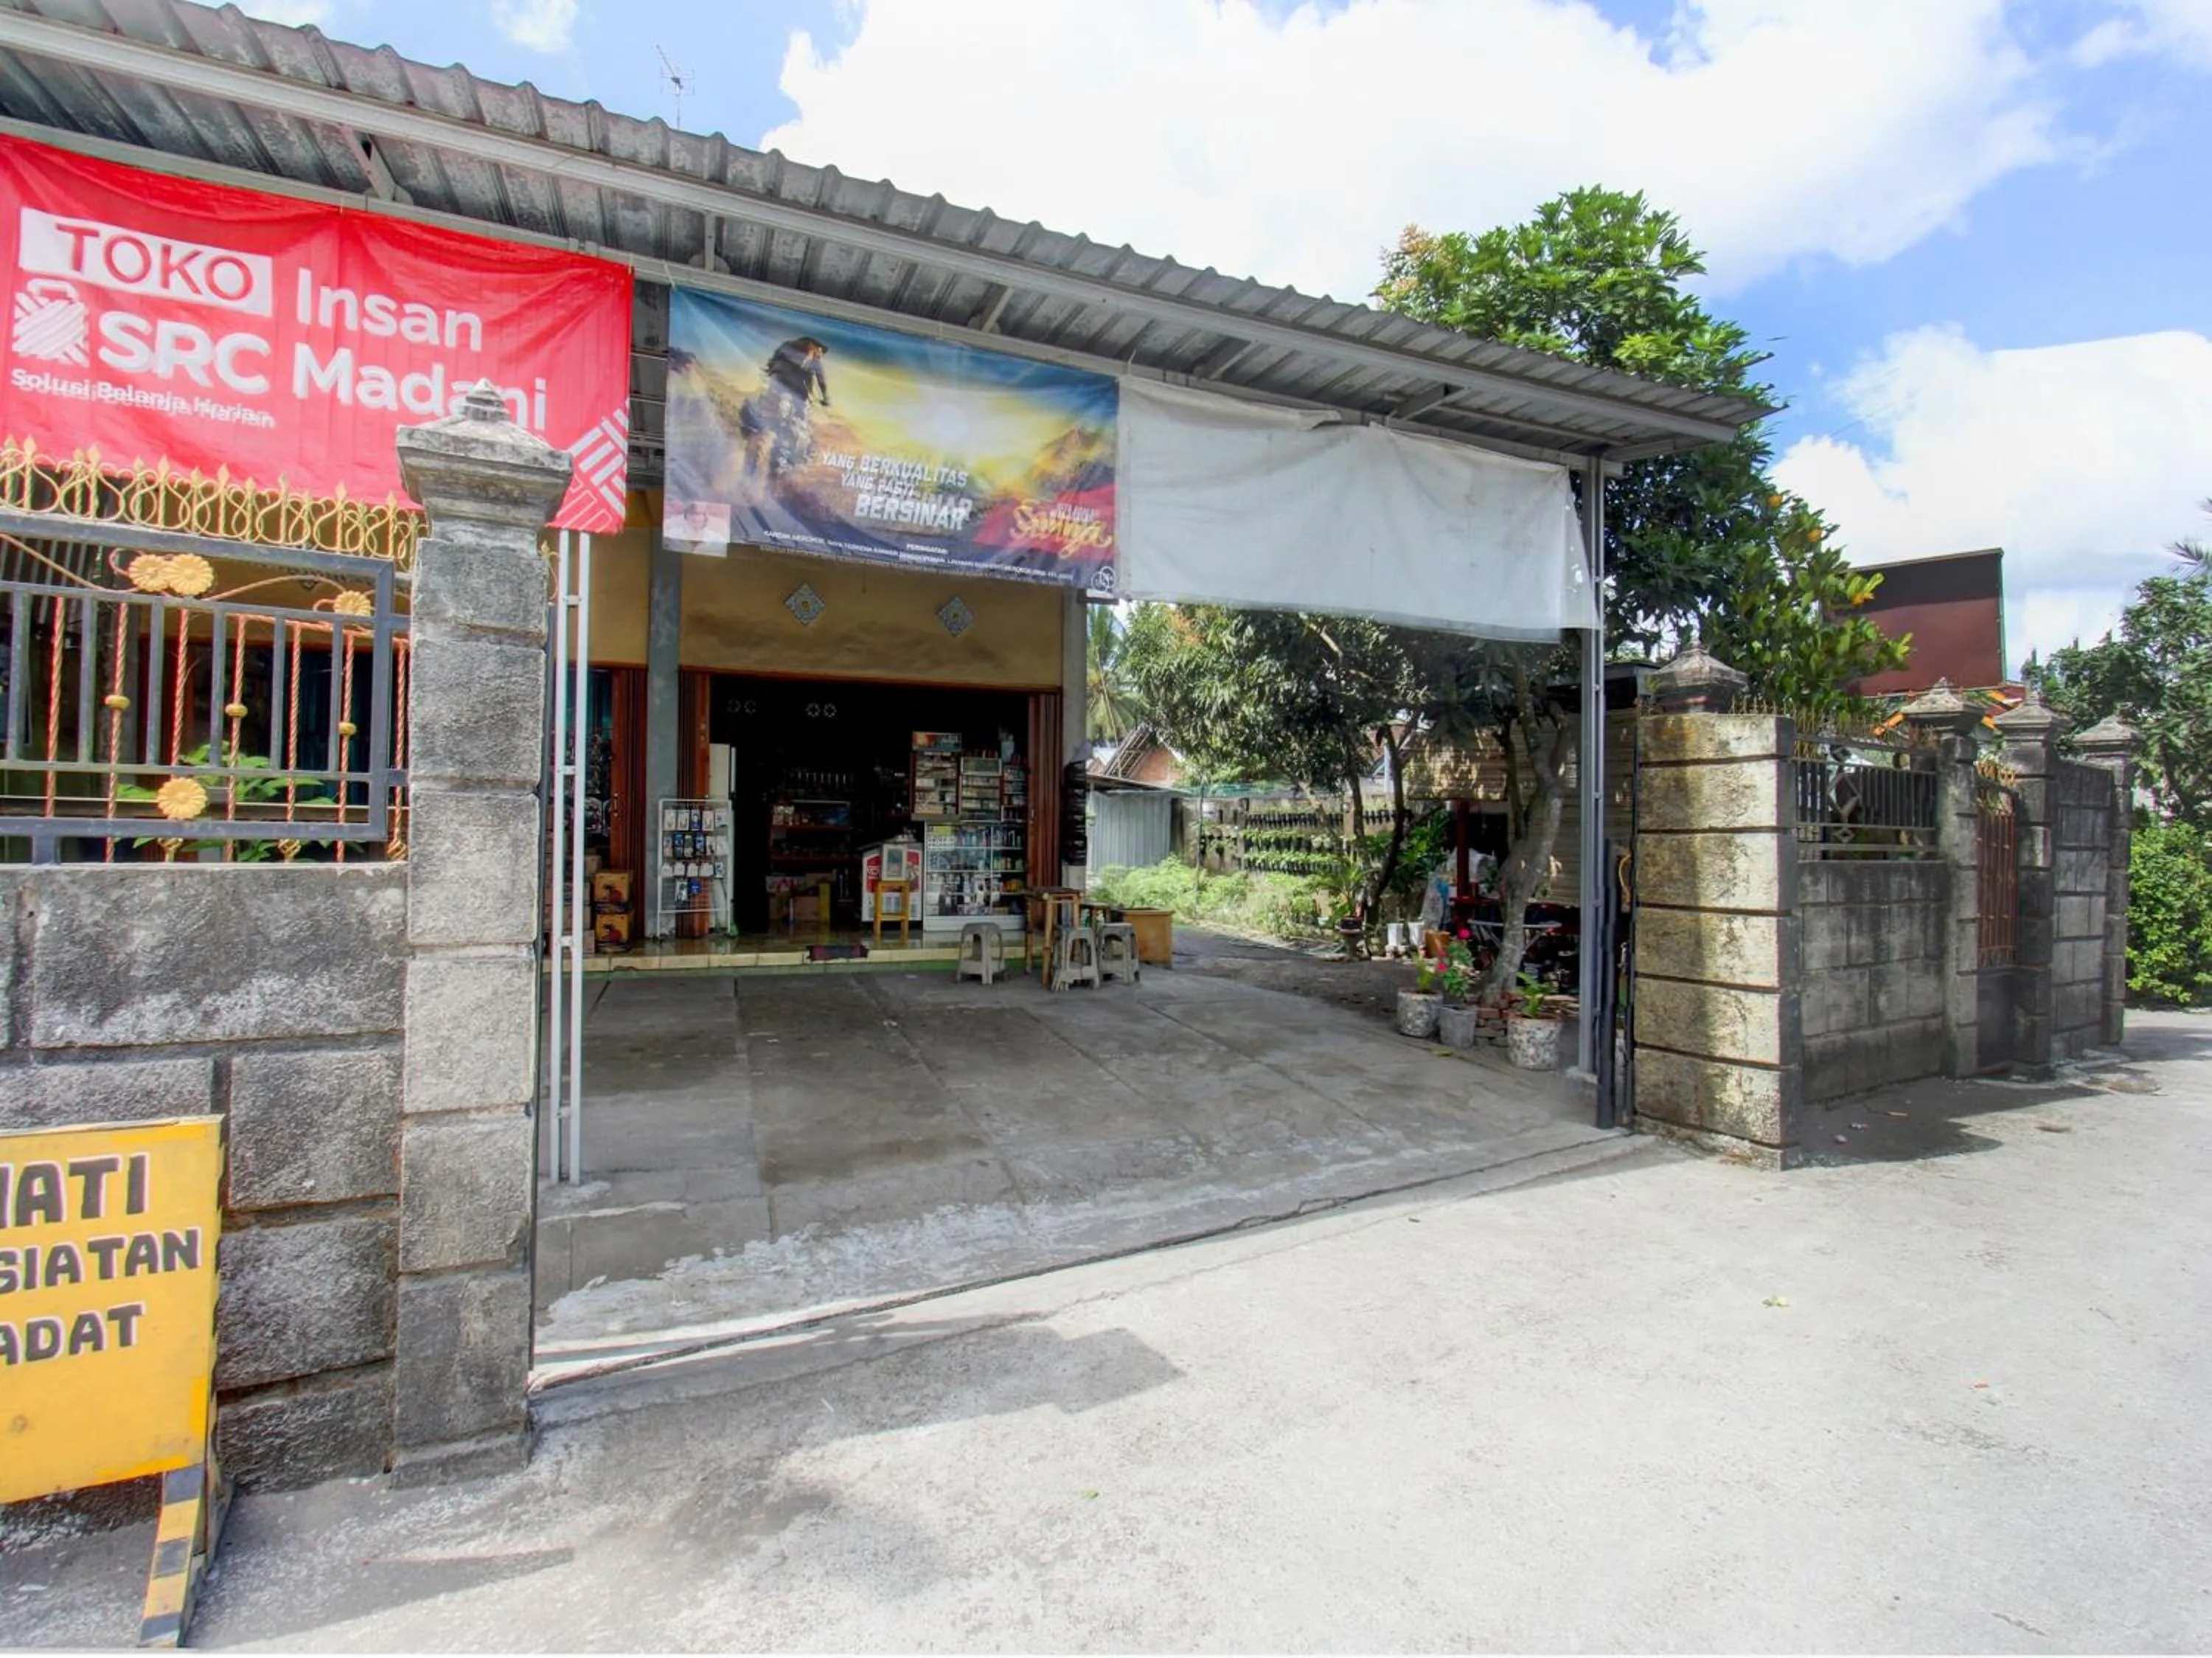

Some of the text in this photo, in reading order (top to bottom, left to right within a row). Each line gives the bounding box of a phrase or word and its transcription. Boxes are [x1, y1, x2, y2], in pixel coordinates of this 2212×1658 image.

[57, 222, 254, 302] TOKO
[296, 268, 481, 352] Insan
[98, 310, 271, 395] SRC
[11, 368, 97, 401] Solusi
[97, 381, 193, 416] Belanja
[821, 451, 856, 470] YANG
[841, 473, 874, 490] YANG
[855, 492, 969, 531] BERSINAR
